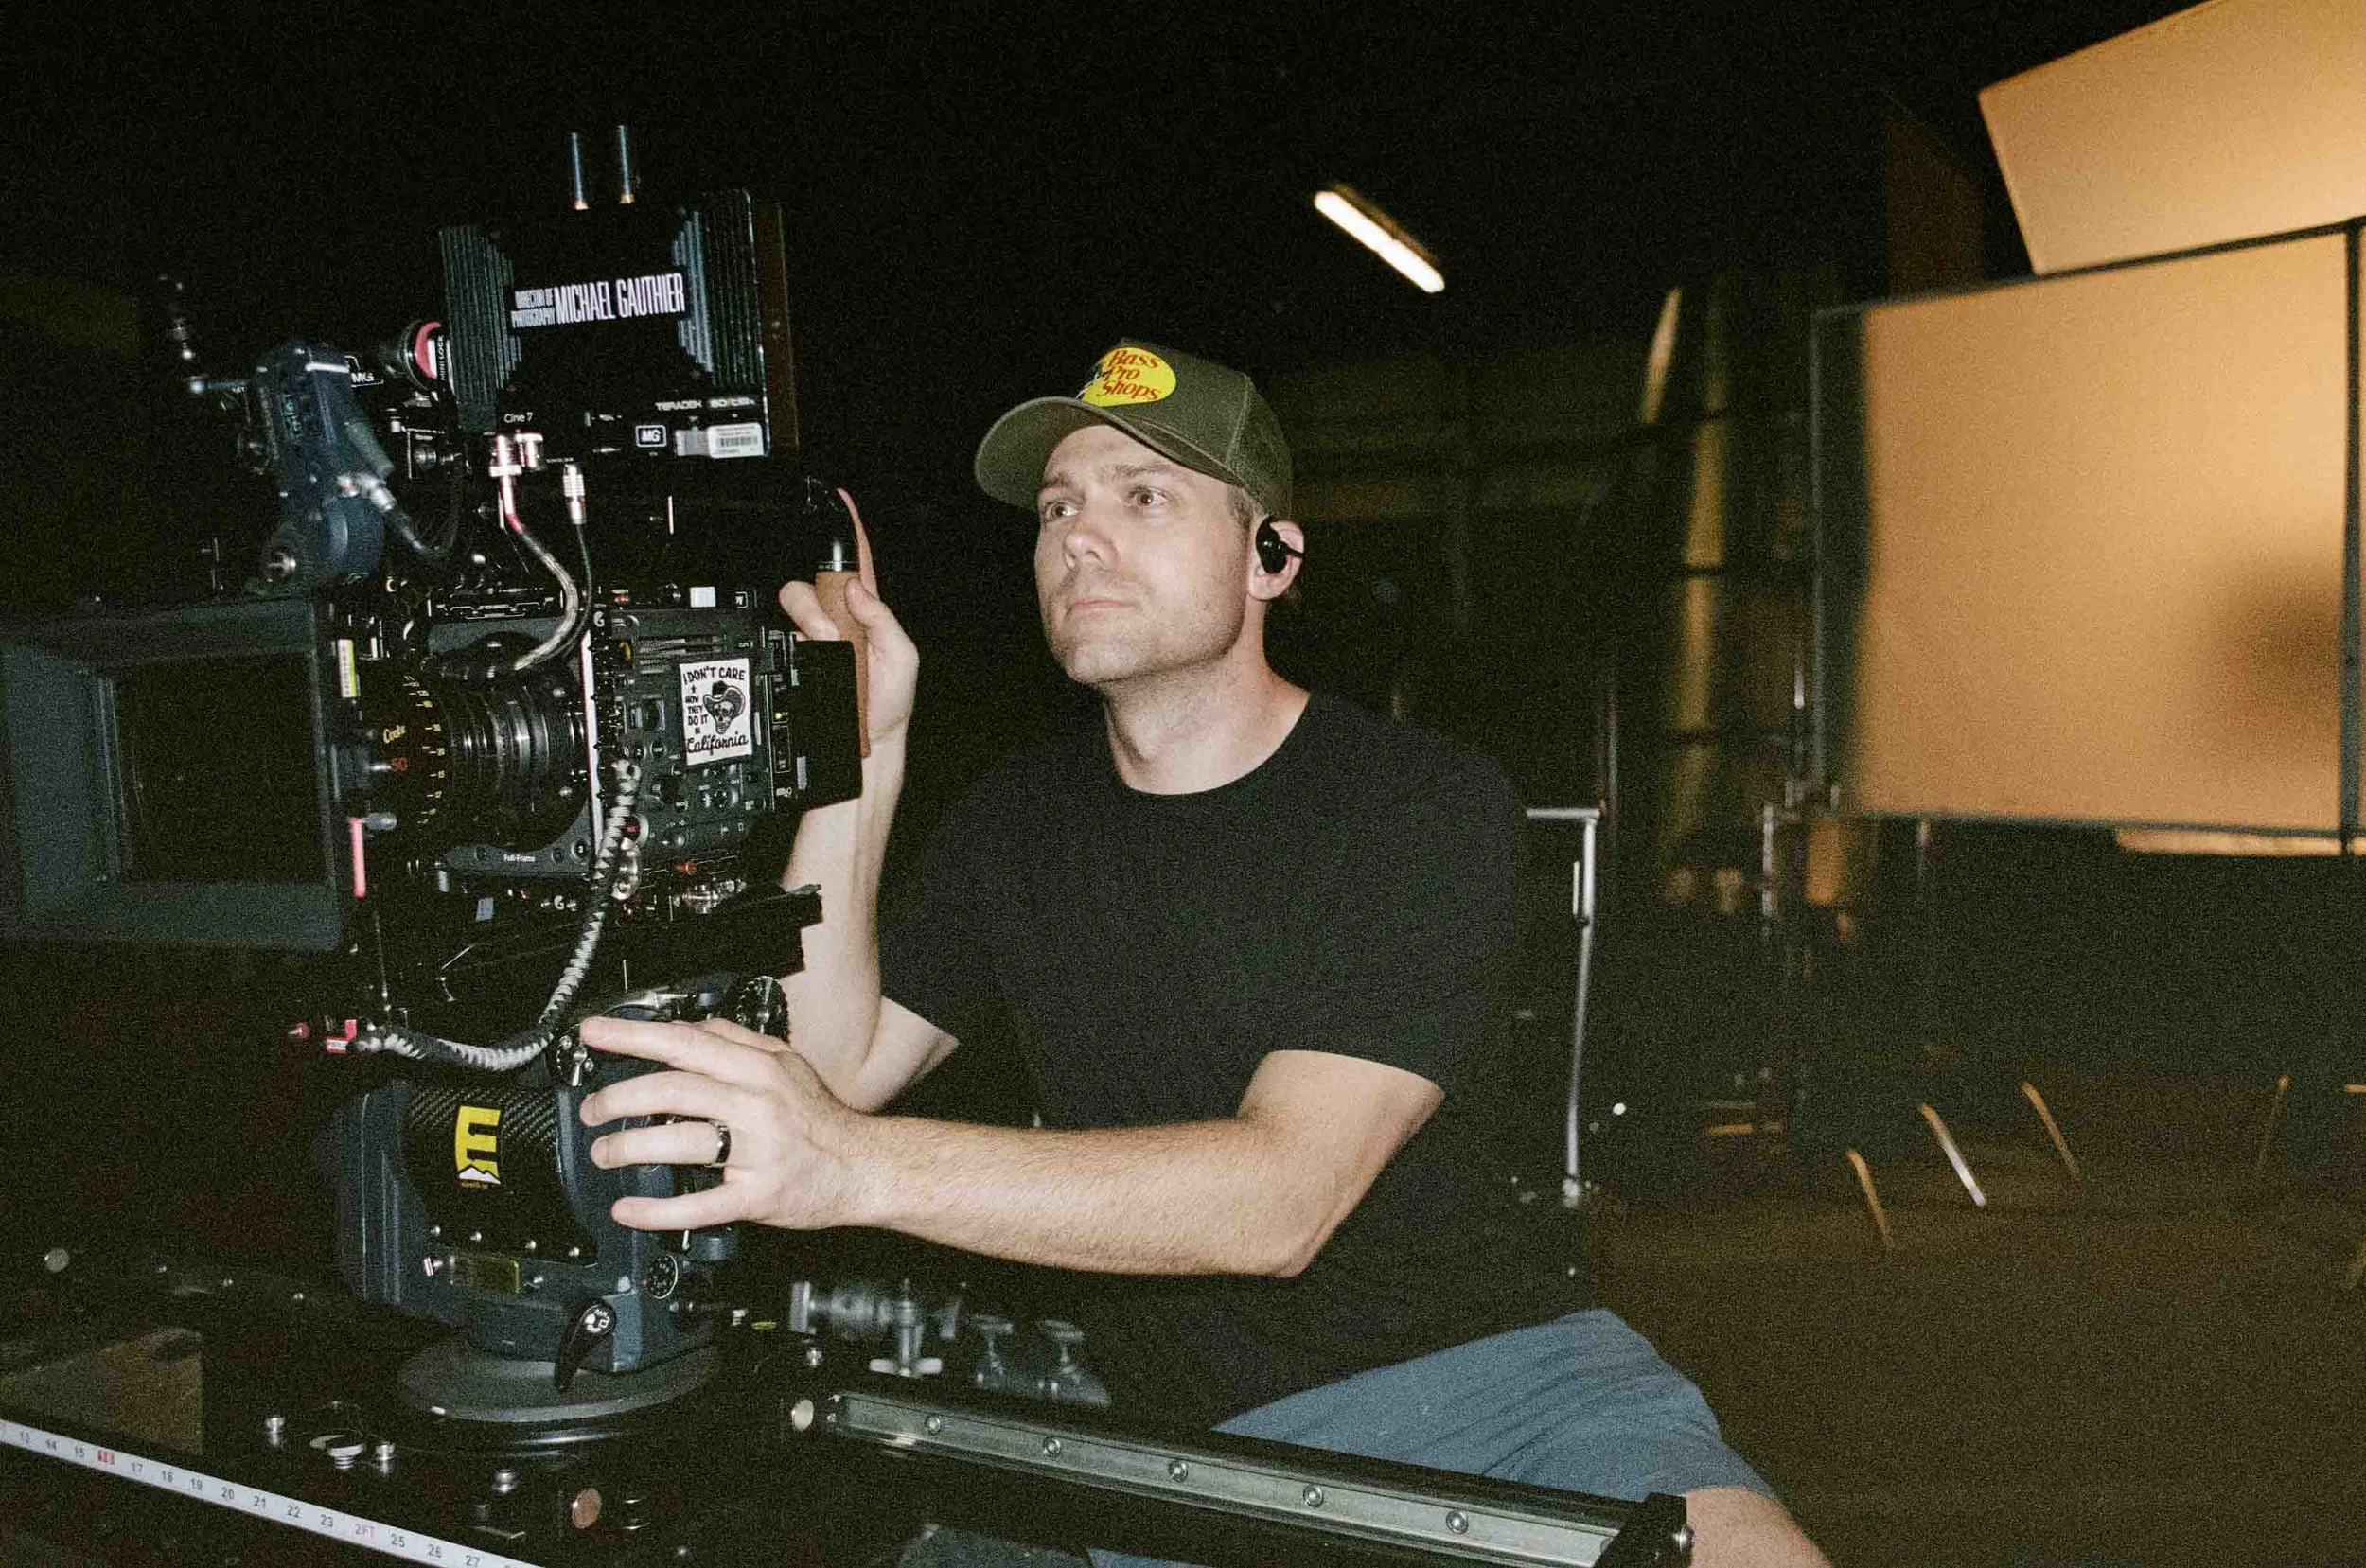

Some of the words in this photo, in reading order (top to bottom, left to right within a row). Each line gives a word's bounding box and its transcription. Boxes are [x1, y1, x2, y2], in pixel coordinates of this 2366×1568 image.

[554, 281, 615, 325] MICHAEL
[615, 273, 685, 318] GAUTHIER
[1107, 349, 1159, 369] Bass
[1103, 365, 1140, 381] Pro
[1102, 379, 1162, 400] Shops
[503, 413, 525, 424] Cine
[526, 412, 533, 422] 7
[682, 673, 688, 685] I
[687, 666, 716, 681] DON'T
[719, 667, 746, 681] CARE
[687, 715, 699, 726] DO
[686, 731, 749, 755] California
[190, 1477, 203, 1490] 19
[221, 1486, 235, 1500] 20
[254, 1495, 266, 1509] 21
[287, 1505, 301, 1518] 22
[320, 1513, 334, 1528] 23
[390, 1534, 406, 1548] 25
[426, 1544, 442, 1559] 26
[465, 1555, 480, 1568] 27
